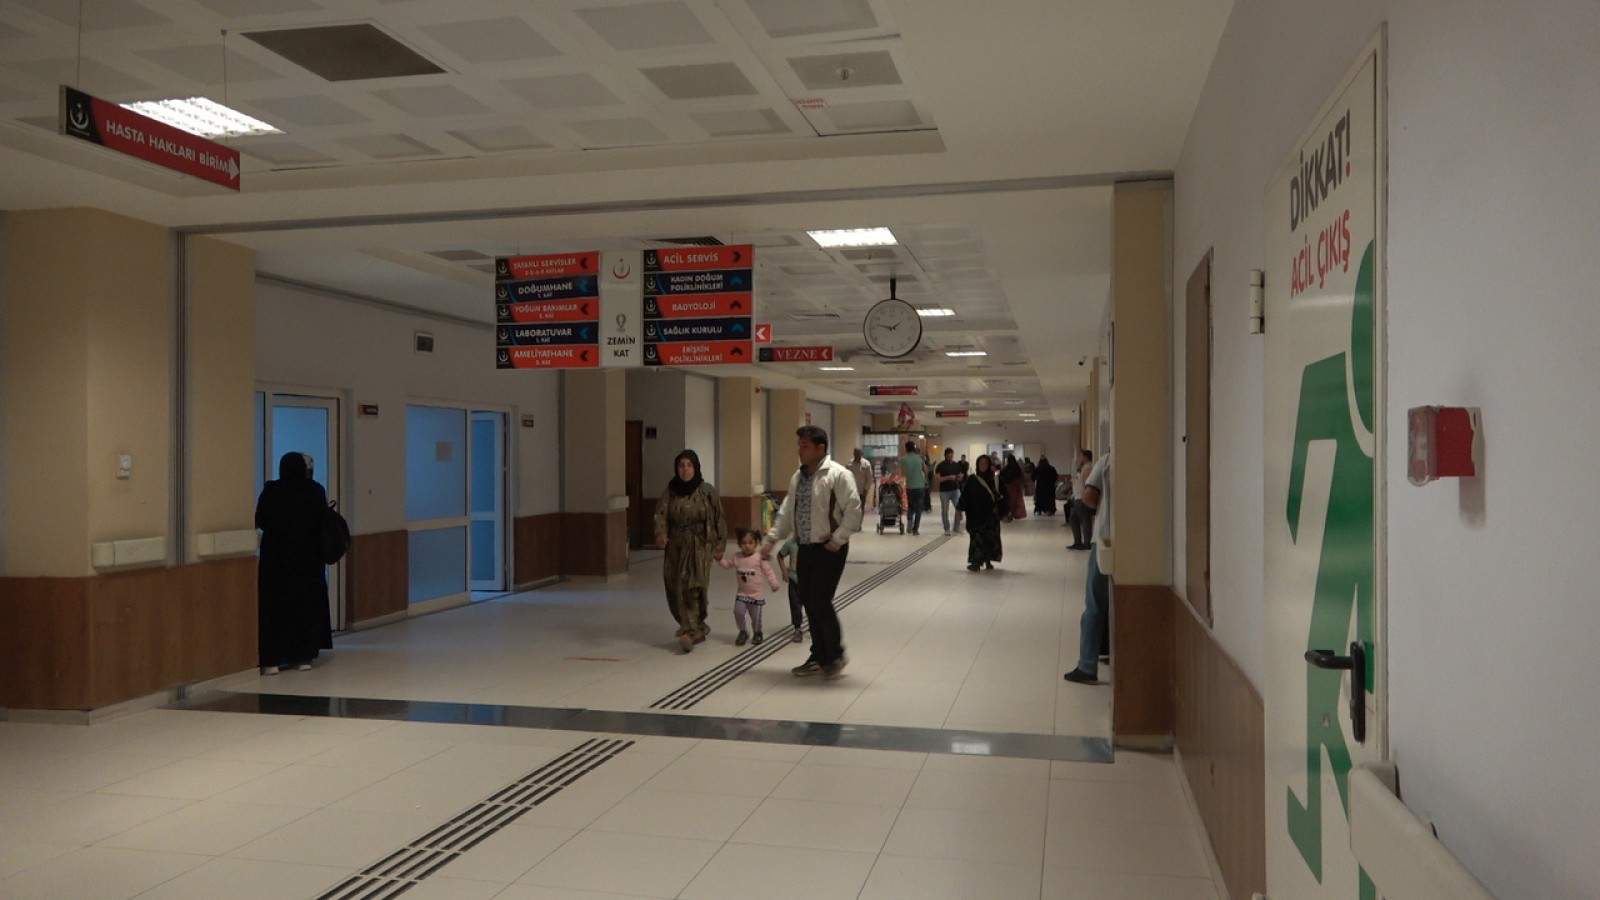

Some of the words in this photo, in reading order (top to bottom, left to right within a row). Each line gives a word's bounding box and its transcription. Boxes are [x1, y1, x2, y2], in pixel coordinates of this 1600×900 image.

[106, 120, 145, 144] HASTA
[149, 134, 196, 161] HAKLARI
[1290, 108, 1350, 232] DİKKAT!
[664, 252, 684, 264] ACİL
[687, 252, 719, 263] SERVİS
[1291, 234, 1314, 299] ACİL
[1317, 208, 1350, 290] ÇIKIŞ
[540, 258, 576, 267] SERVİSLER
[694, 273, 723, 282] DOĞUM
[518, 282, 573, 294] DOĞUMHANE
[670, 282, 723, 291] POLİKLİNİKLERİ
[514, 304, 540, 313] YOĞUN
[672, 301, 716, 311] RADYOLOJİ
[515, 328, 572, 337] LABORATUVAR
[663, 326, 690, 336] SAĞLIK
[692, 326, 722, 334] KURULU
[607, 335, 636, 346] ZEMİN
[514, 349, 574, 358] AMELİYATHANE
[682, 345, 709, 354] ERİŞKİN
[777, 349, 817, 359] VEZNE
[670, 354, 723, 363] POLİKLİNİKLERİ
